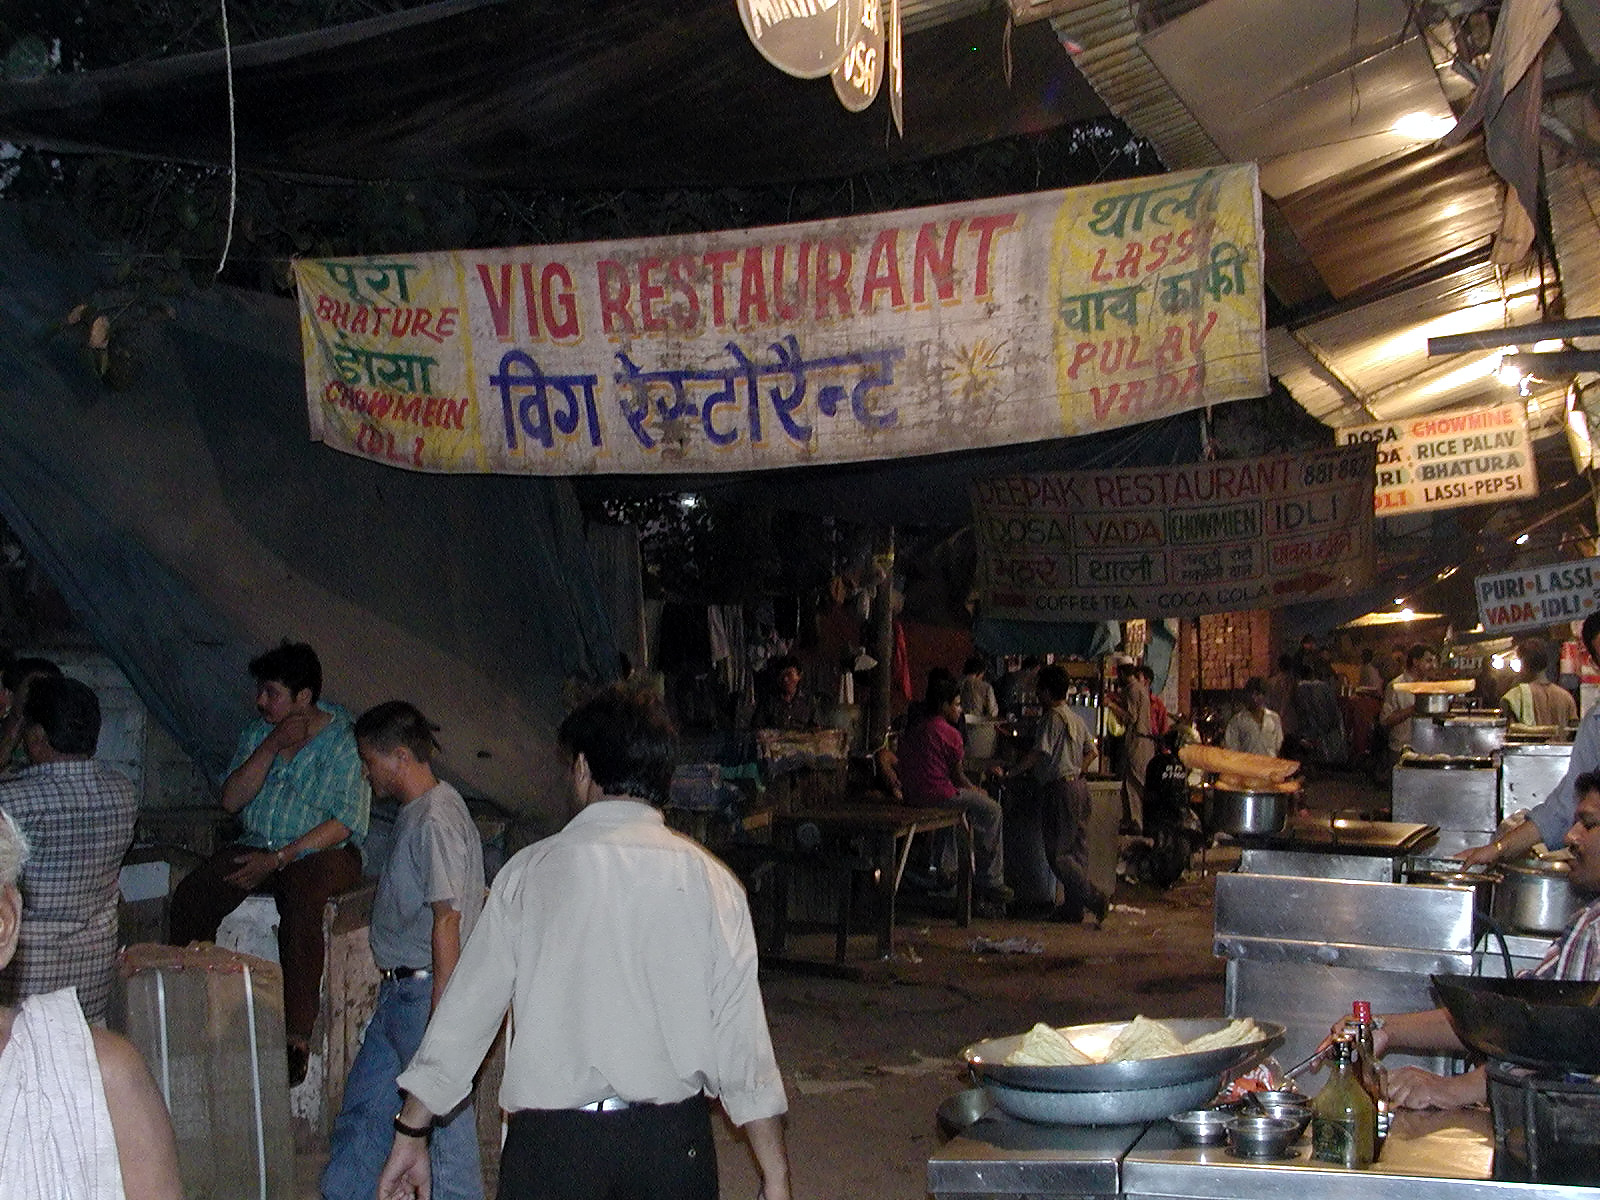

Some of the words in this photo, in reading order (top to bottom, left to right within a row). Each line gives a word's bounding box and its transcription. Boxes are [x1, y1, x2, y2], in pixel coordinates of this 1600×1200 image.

[476, 261, 581, 340] VIG
[597, 212, 1020, 335] RESTAURANT
[315, 293, 460, 344] BHATURE
[1067, 311, 1218, 381] PULAV
[325, 380, 469, 431] CHOWMEIN
[490, 348, 602, 450] विग
[1088, 365, 1205, 422] VADA
[356, 422, 425, 468] IDLI
[1348, 427, 1397, 447] DOSA
[1411, 408, 1513, 438] CHOWMINE
[1417, 439, 1457, 460] RICE
[1462, 430, 1515, 453] PALAV
[970, 475, 1086, 508] DEEPAK
[1095, 457, 1293, 508] RESTAURANT
[1421, 453, 1520, 481] BHATURA
[1424, 474, 1523, 503] LASSI-PEPSI
[979, 518, 1068, 546] DOSA
[1084, 518, 1162, 546] VADA
[1274, 494, 1338, 530] IDLI
[1158, 590, 1210, 610] COCA
[1481, 576, 1526, 602] PURI
[1534, 566, 1594, 596] LASSI
[1486, 602, 1537, 626] VADA
[1541, 594, 1581, 618] IDLI
